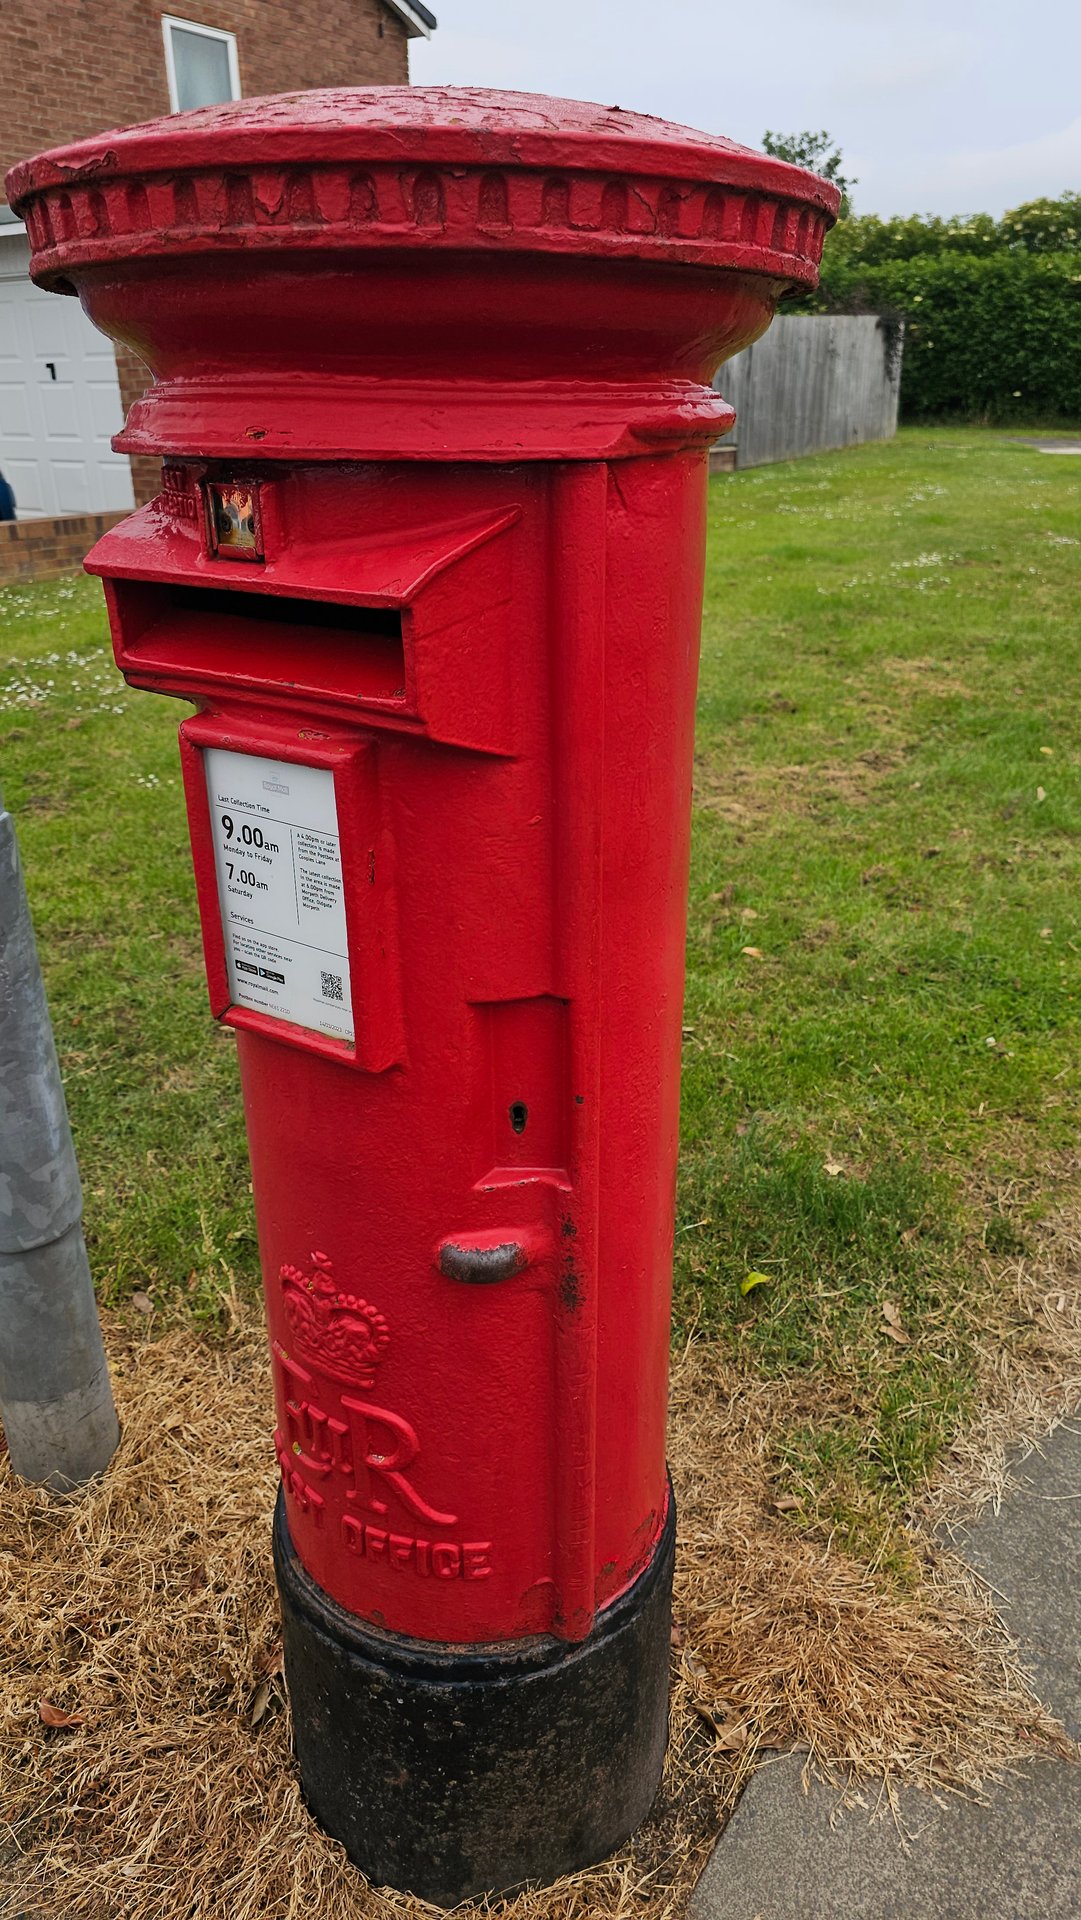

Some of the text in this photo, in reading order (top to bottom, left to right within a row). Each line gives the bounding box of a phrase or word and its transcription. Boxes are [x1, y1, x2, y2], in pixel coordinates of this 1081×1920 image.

[218, 794, 270, 813] Last Collection Time
[222, 814, 279, 853] 9.00am
[223, 843, 246, 858] Monday
[254, 852, 272, 865] Friday
[298, 841, 317, 850] collection
[226, 862, 268, 891] 7.00am
[322, 874, 341, 883] collection
[228, 885, 253, 900] Saturday
[320, 894, 337, 904] Delivery
[230, 912, 254, 924] Services
[342, 1513, 493, 1580] OFFICE
